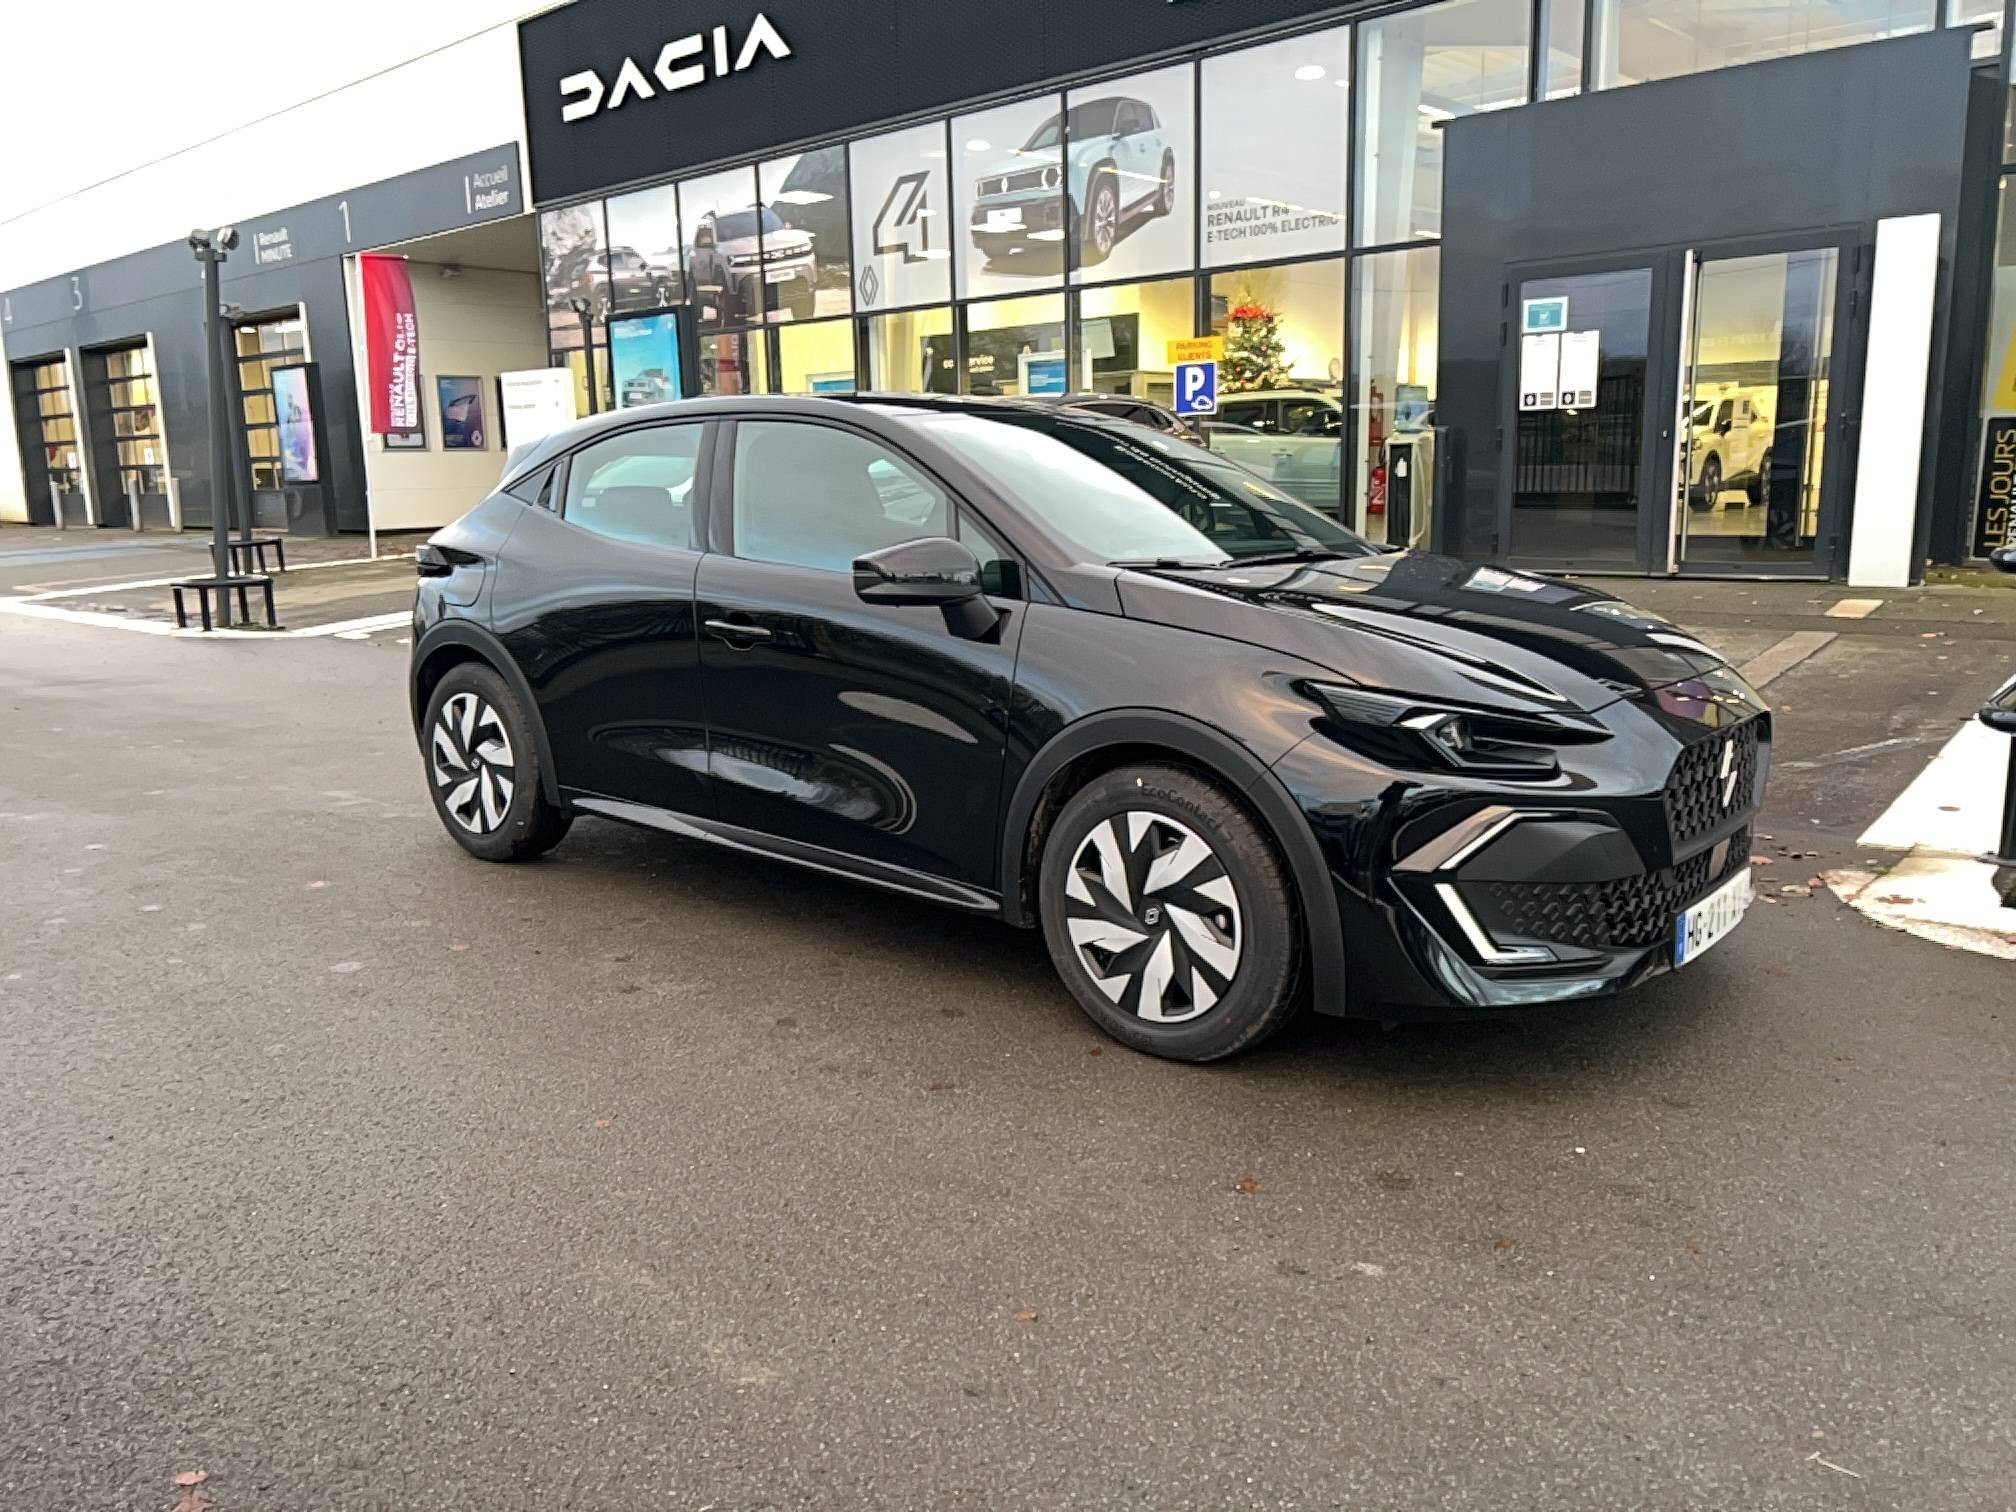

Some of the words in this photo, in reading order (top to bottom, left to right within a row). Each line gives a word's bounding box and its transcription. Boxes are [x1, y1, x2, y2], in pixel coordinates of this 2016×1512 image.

[560, 12, 792, 123] DACIA
[473, 164, 508, 188] Accueil
[474, 188, 510, 211] Atelier
[1207, 199, 1244, 211] NOUVEAU
[1207, 206, 1269, 228] RENAULT
[338, 200, 351, 243] 1
[1249, 222, 1278, 237] 100%
[71, 276, 83, 311] 3
[1185, 367, 1205, 402] P
[1990, 428, 2016, 505] JOURS
[1983, 507, 2008, 548] LES
